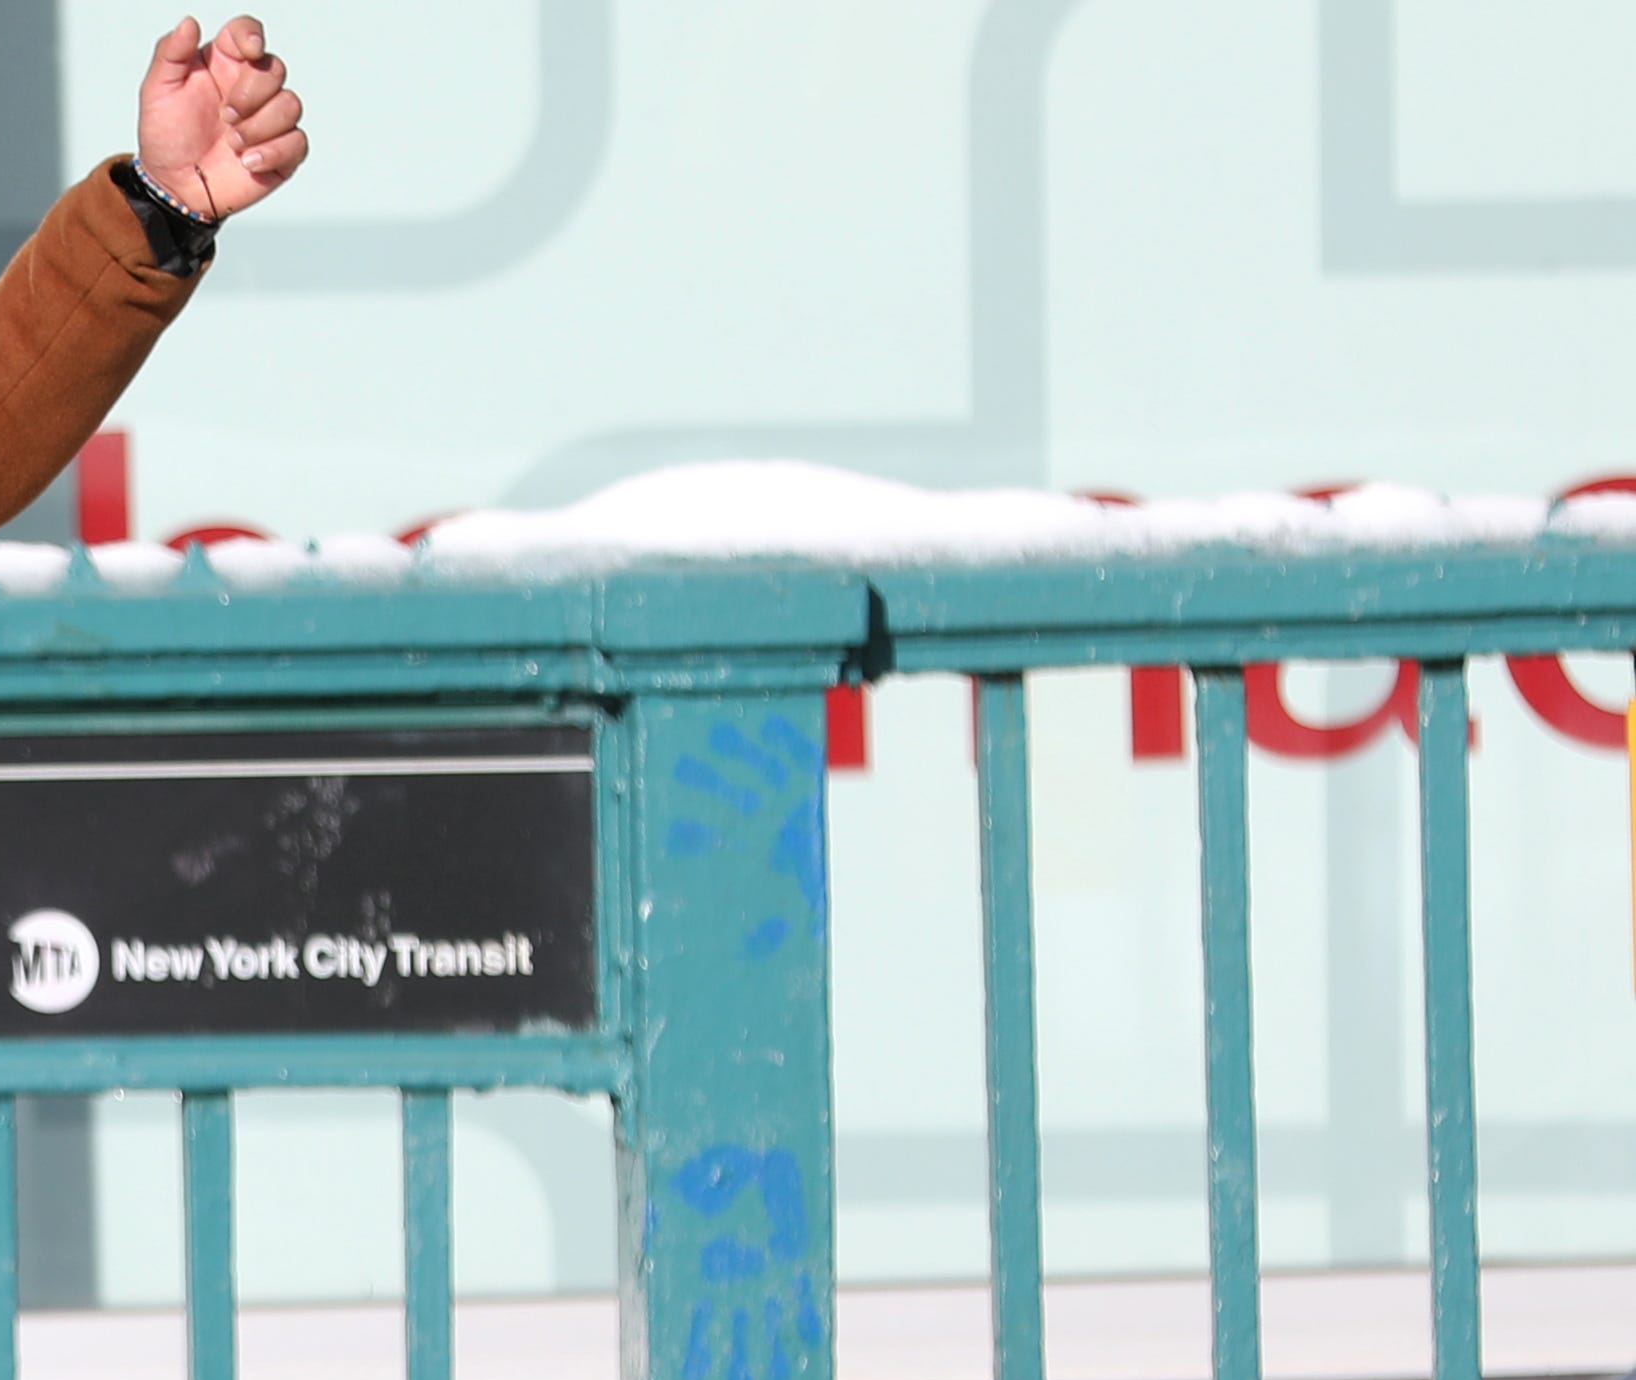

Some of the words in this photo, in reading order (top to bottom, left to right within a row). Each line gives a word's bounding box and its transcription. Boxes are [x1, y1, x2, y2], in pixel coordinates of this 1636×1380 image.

[111, 940, 204, 982] New
[206, 937, 300, 980] York
[303, 936, 387, 987] City
[390, 934, 534, 977] Transit
